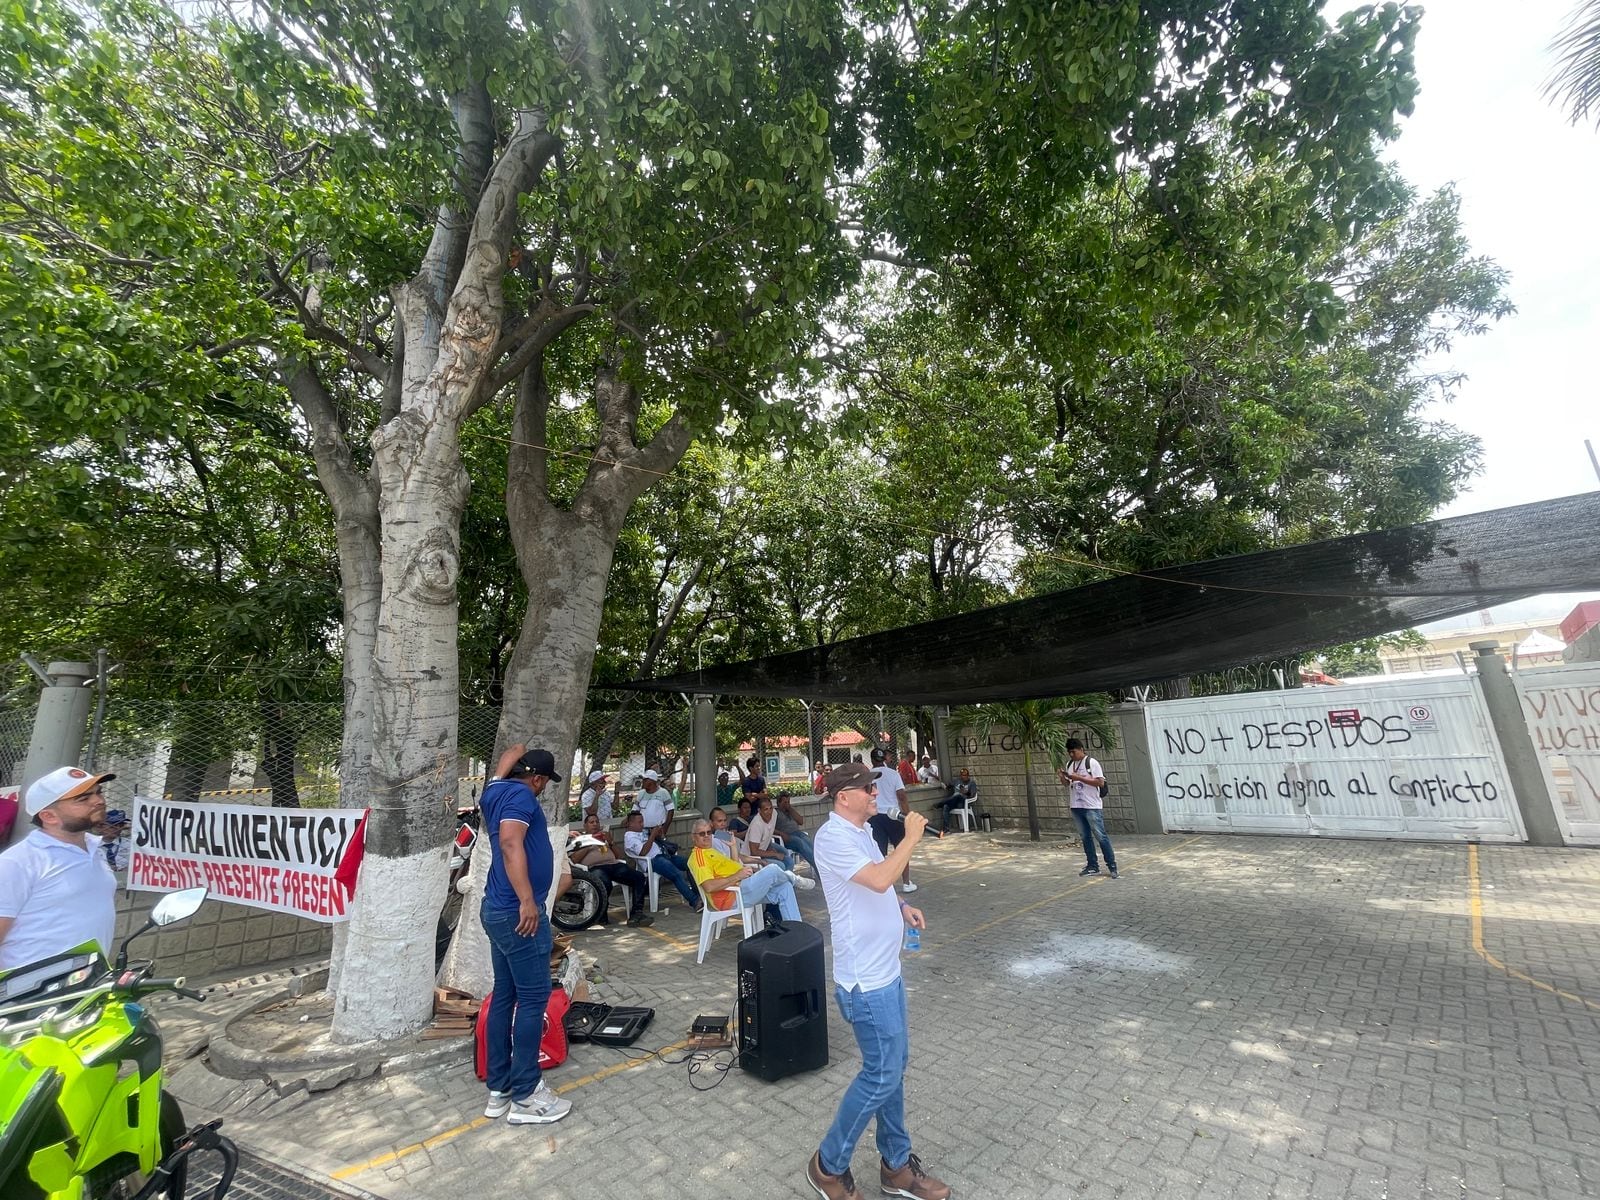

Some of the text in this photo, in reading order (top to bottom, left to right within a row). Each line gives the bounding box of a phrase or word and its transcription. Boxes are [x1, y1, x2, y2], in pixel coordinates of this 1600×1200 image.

[955, 735, 978, 755] NO
[1163, 728, 1206, 755] NO
[1211, 727, 1234, 752] +
[1242, 715, 1412, 752] DESPIDOS
[1277, 772, 1336, 808] digna
[131, 852, 201, 889] PRESENTE
[202, 861, 280, 905] PRESENTE
